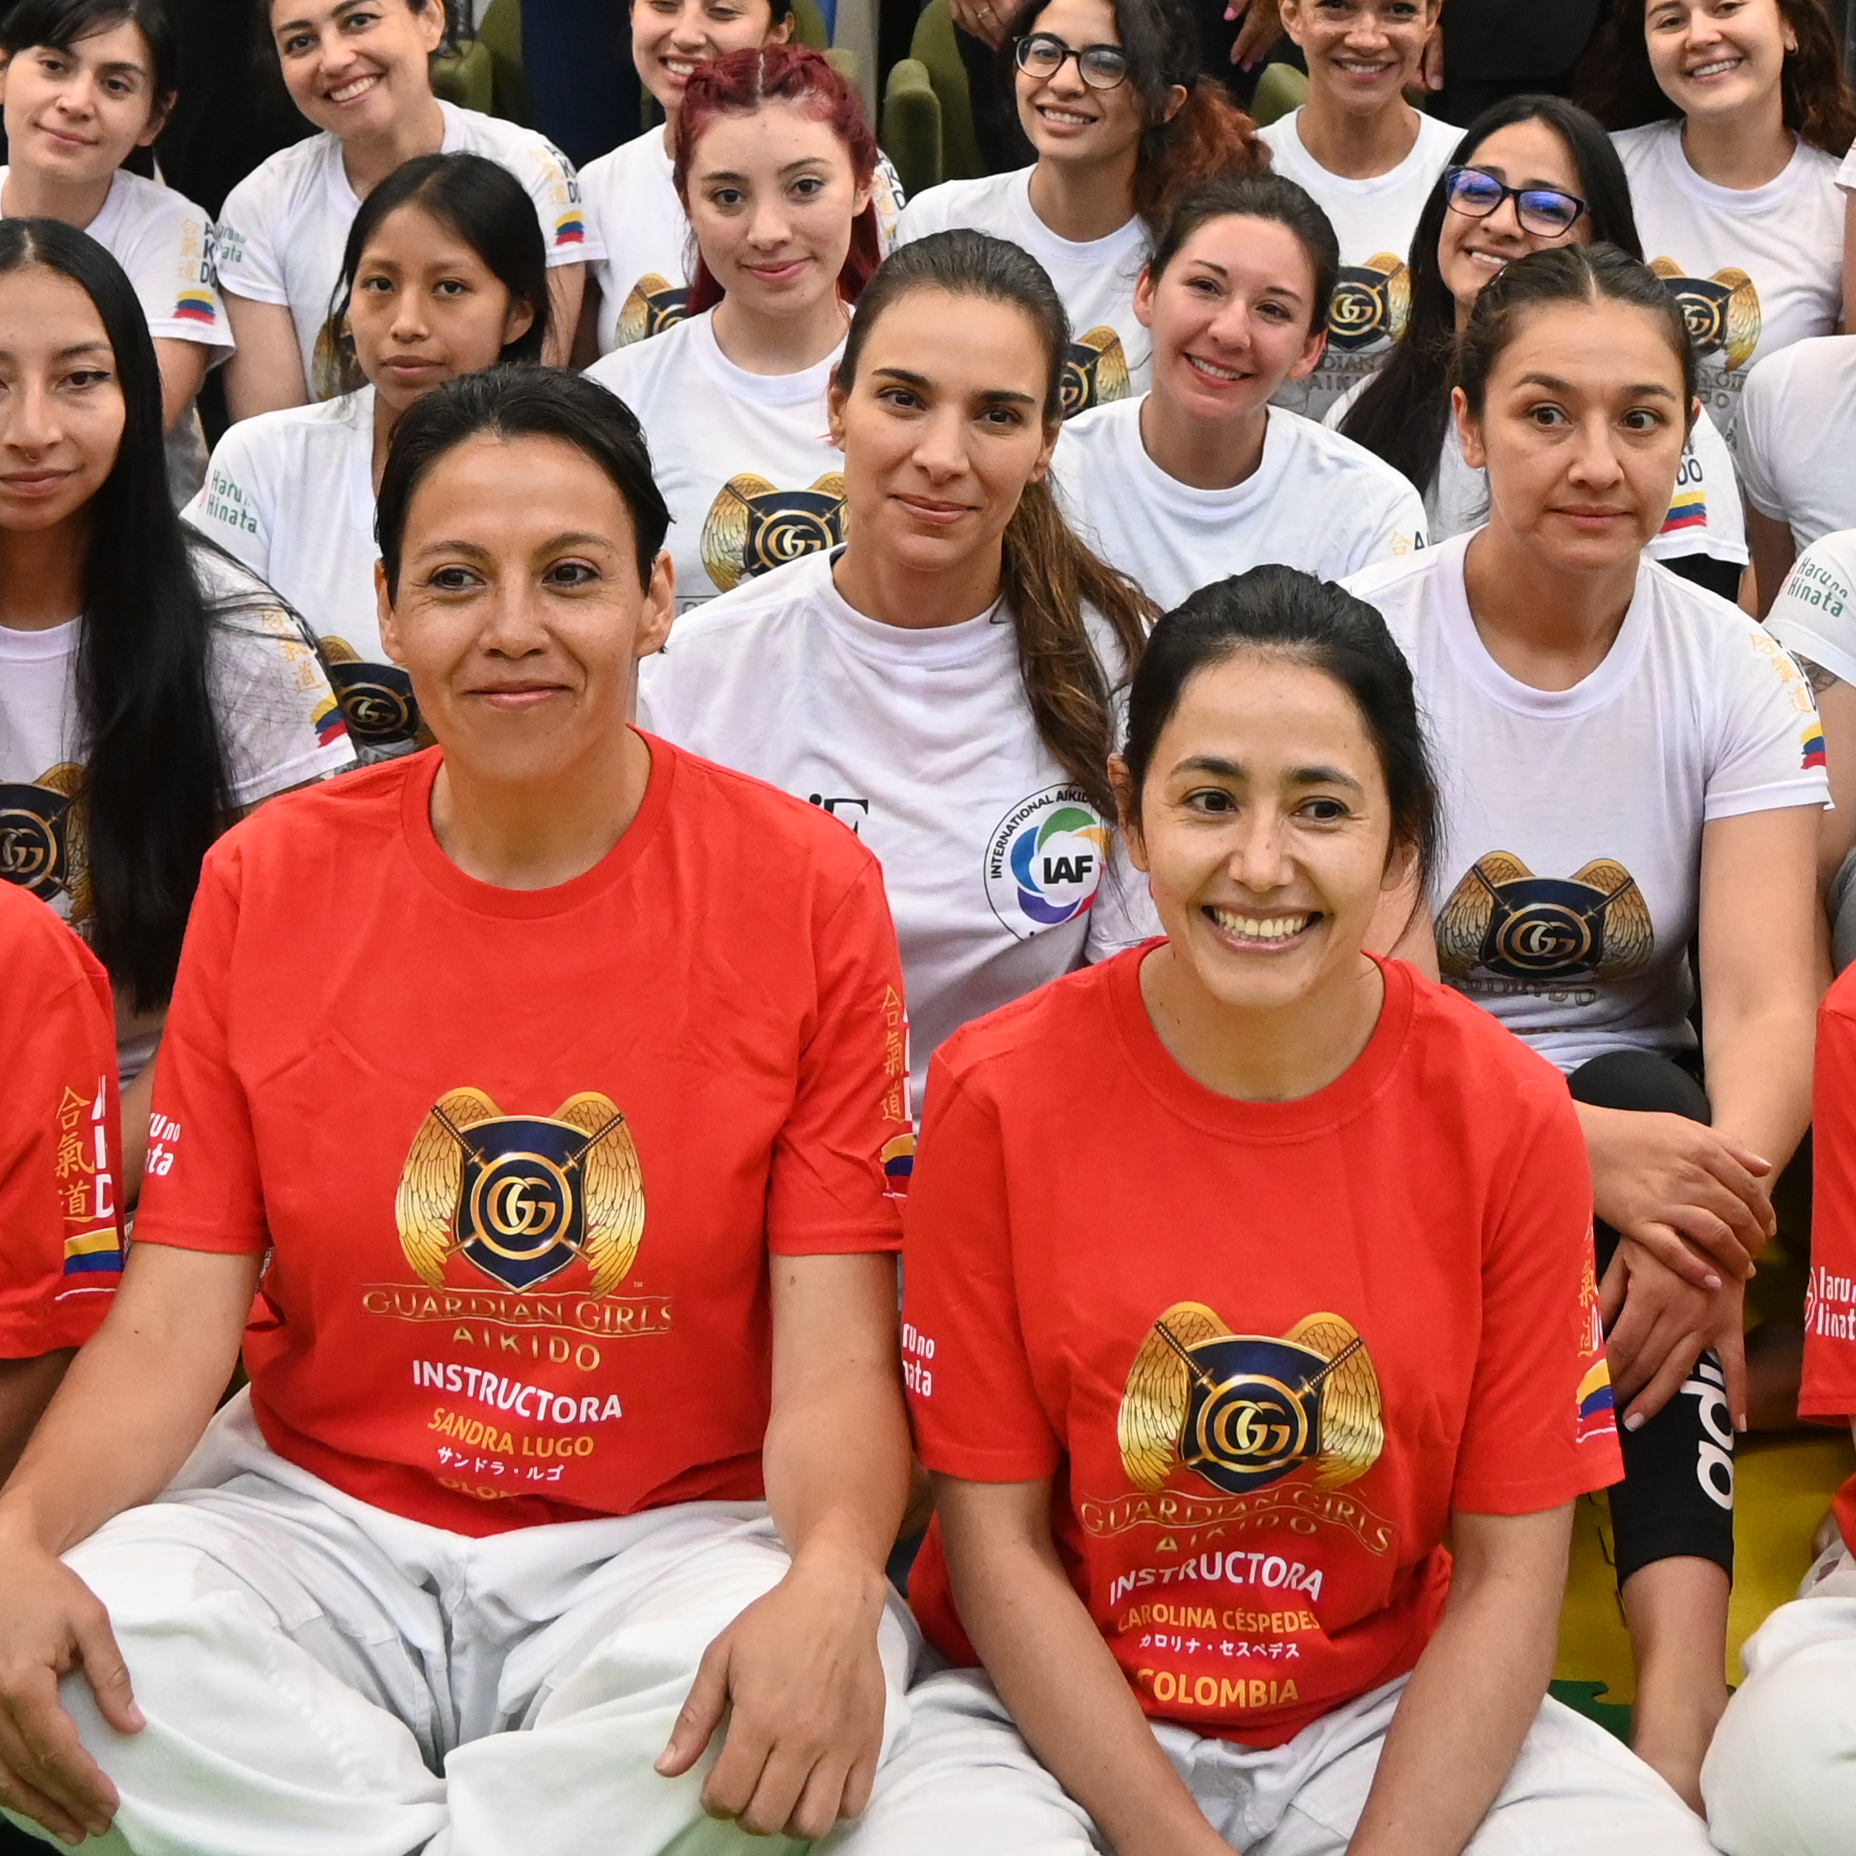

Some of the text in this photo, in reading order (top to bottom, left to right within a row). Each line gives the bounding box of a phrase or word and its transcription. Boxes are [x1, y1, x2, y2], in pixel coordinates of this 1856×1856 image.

[1787, 576, 1845, 619] Hinata
[990, 793, 1054, 879] INTERNATIONAL
[1043, 855, 1094, 885] IAF
[362, 1290, 673, 1334] GUARDIAN GIRLS
[453, 1324, 601, 1372] AIKIDO
[413, 1359, 623, 1424] INSTRUCTORA
[427, 1407, 594, 1458] SANDRA LUGO
[1080, 1489, 1393, 1555] GUARDIAN GIRLS
[1109, 1550, 1324, 1607] INSTRUCTORA
[1118, 1602, 1321, 1634] CAROLINA CÉSPEDES
[1137, 1668, 1300, 1709] COLOMBIA
